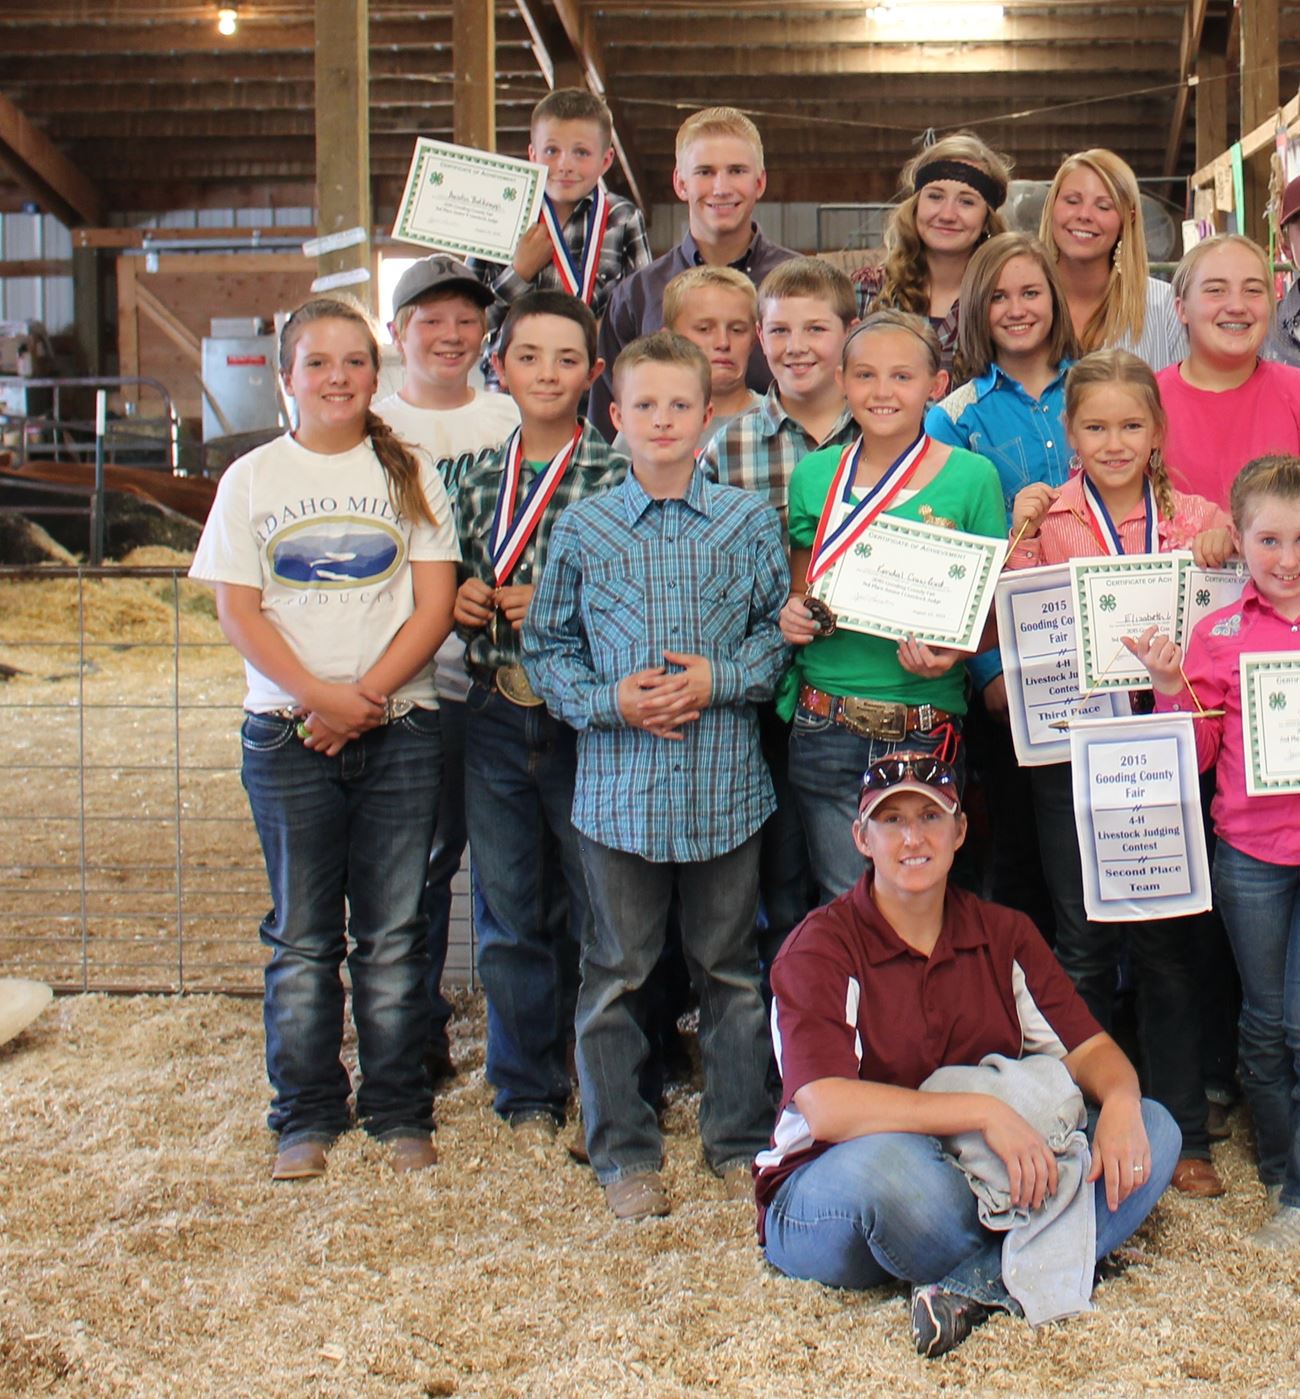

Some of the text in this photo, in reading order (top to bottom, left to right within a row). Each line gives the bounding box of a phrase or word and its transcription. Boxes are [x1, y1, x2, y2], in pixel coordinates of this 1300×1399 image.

[257, 496, 406, 542] IDAHO MILK
[1205, 575, 1237, 584] CERTIFICATE
[1042, 600, 1067, 614] 2015
[1020, 617, 1059, 633] Gooding
[1049, 632, 1069, 644] Fair
[1056, 659, 1071, 669] 4-H
[1025, 672, 1067, 686] Livestock
[1049, 685, 1078, 696] Contes
[1038, 709, 1067, 721] Third
[1120, 754, 1147, 767] 2015
[1096, 769, 1174, 785] Gooding County
[1125, 787, 1145, 798] Fair
[1129, 816, 1145, 825] 4-H
[1098, 826, 1180, 840] Livestock Judging
[1122, 842, 1158, 852] Contest
[1105, 864, 1182, 877] Second Place
[1129, 883, 1160, 892] Team
